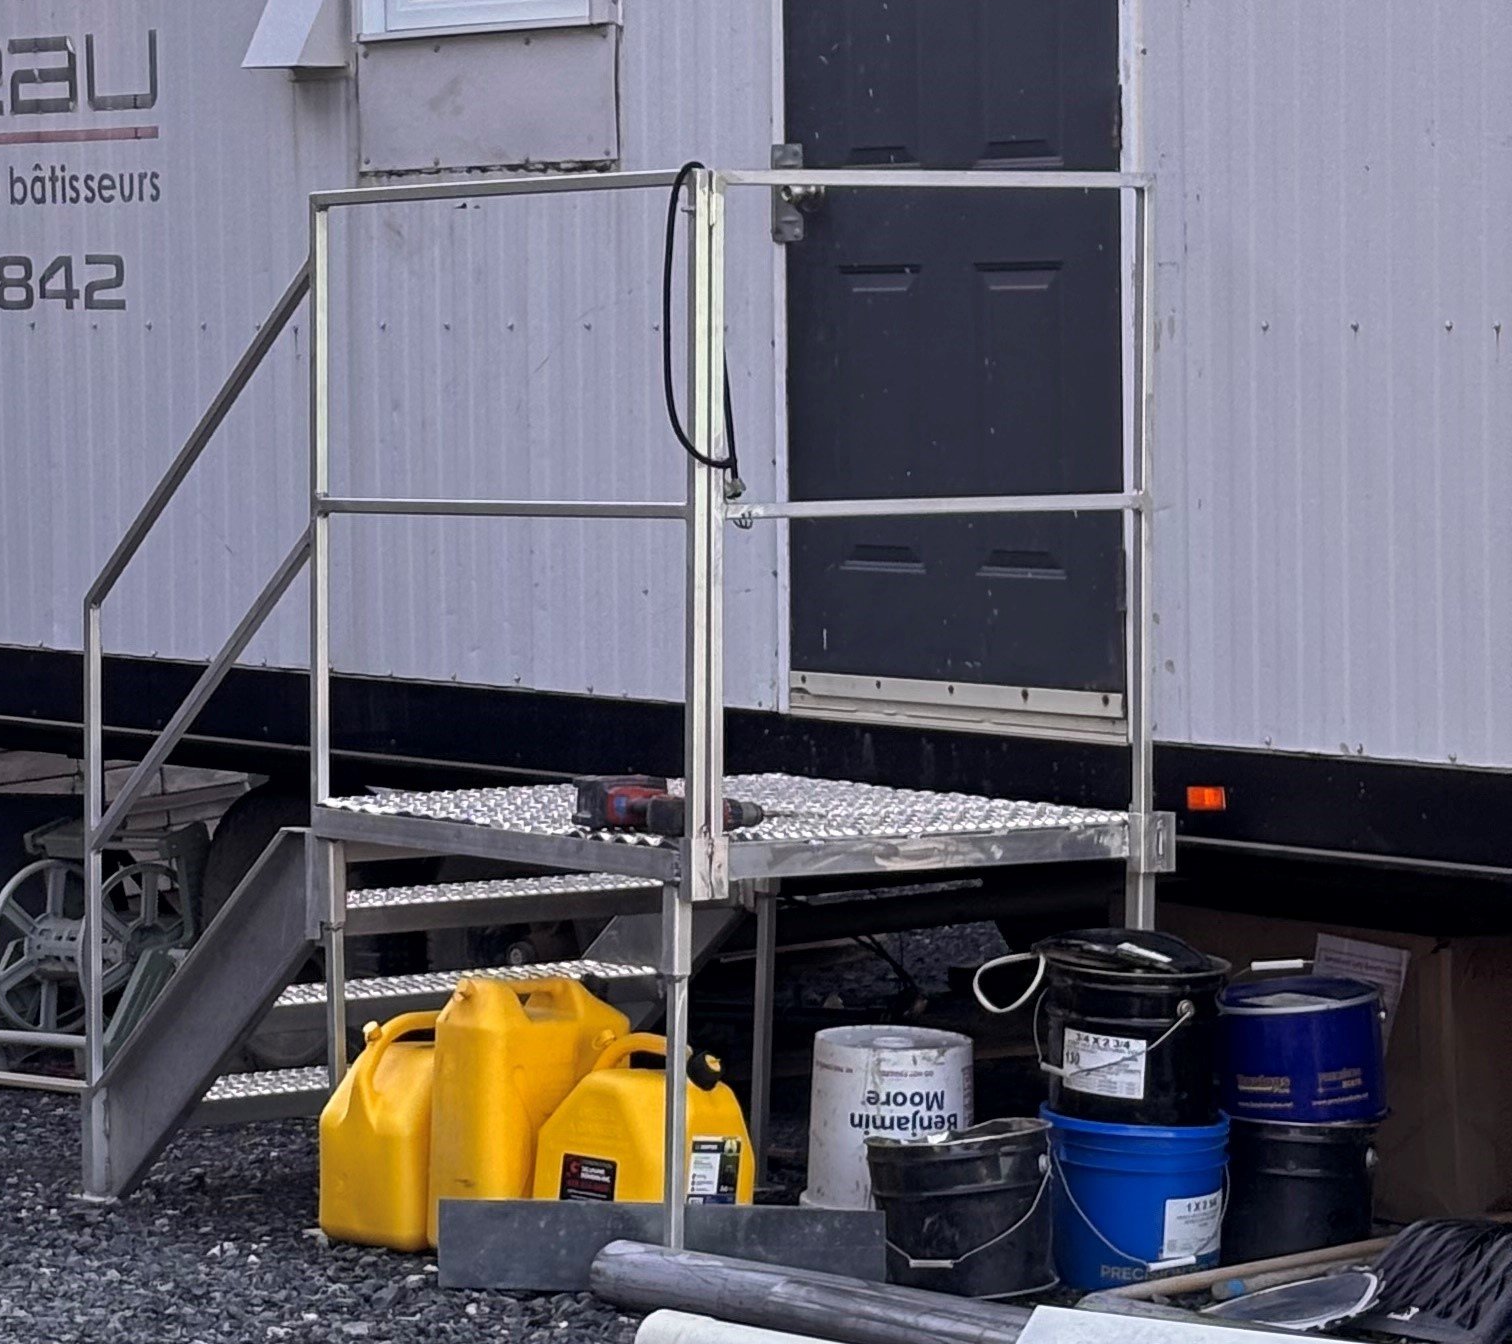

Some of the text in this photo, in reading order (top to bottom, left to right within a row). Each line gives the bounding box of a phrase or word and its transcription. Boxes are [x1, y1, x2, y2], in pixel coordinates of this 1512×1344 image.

[8, 162, 162, 206] bâtisseurs
[866, 1089, 945, 1111] Moore
[849, 1109, 958, 1137] Benjamin
